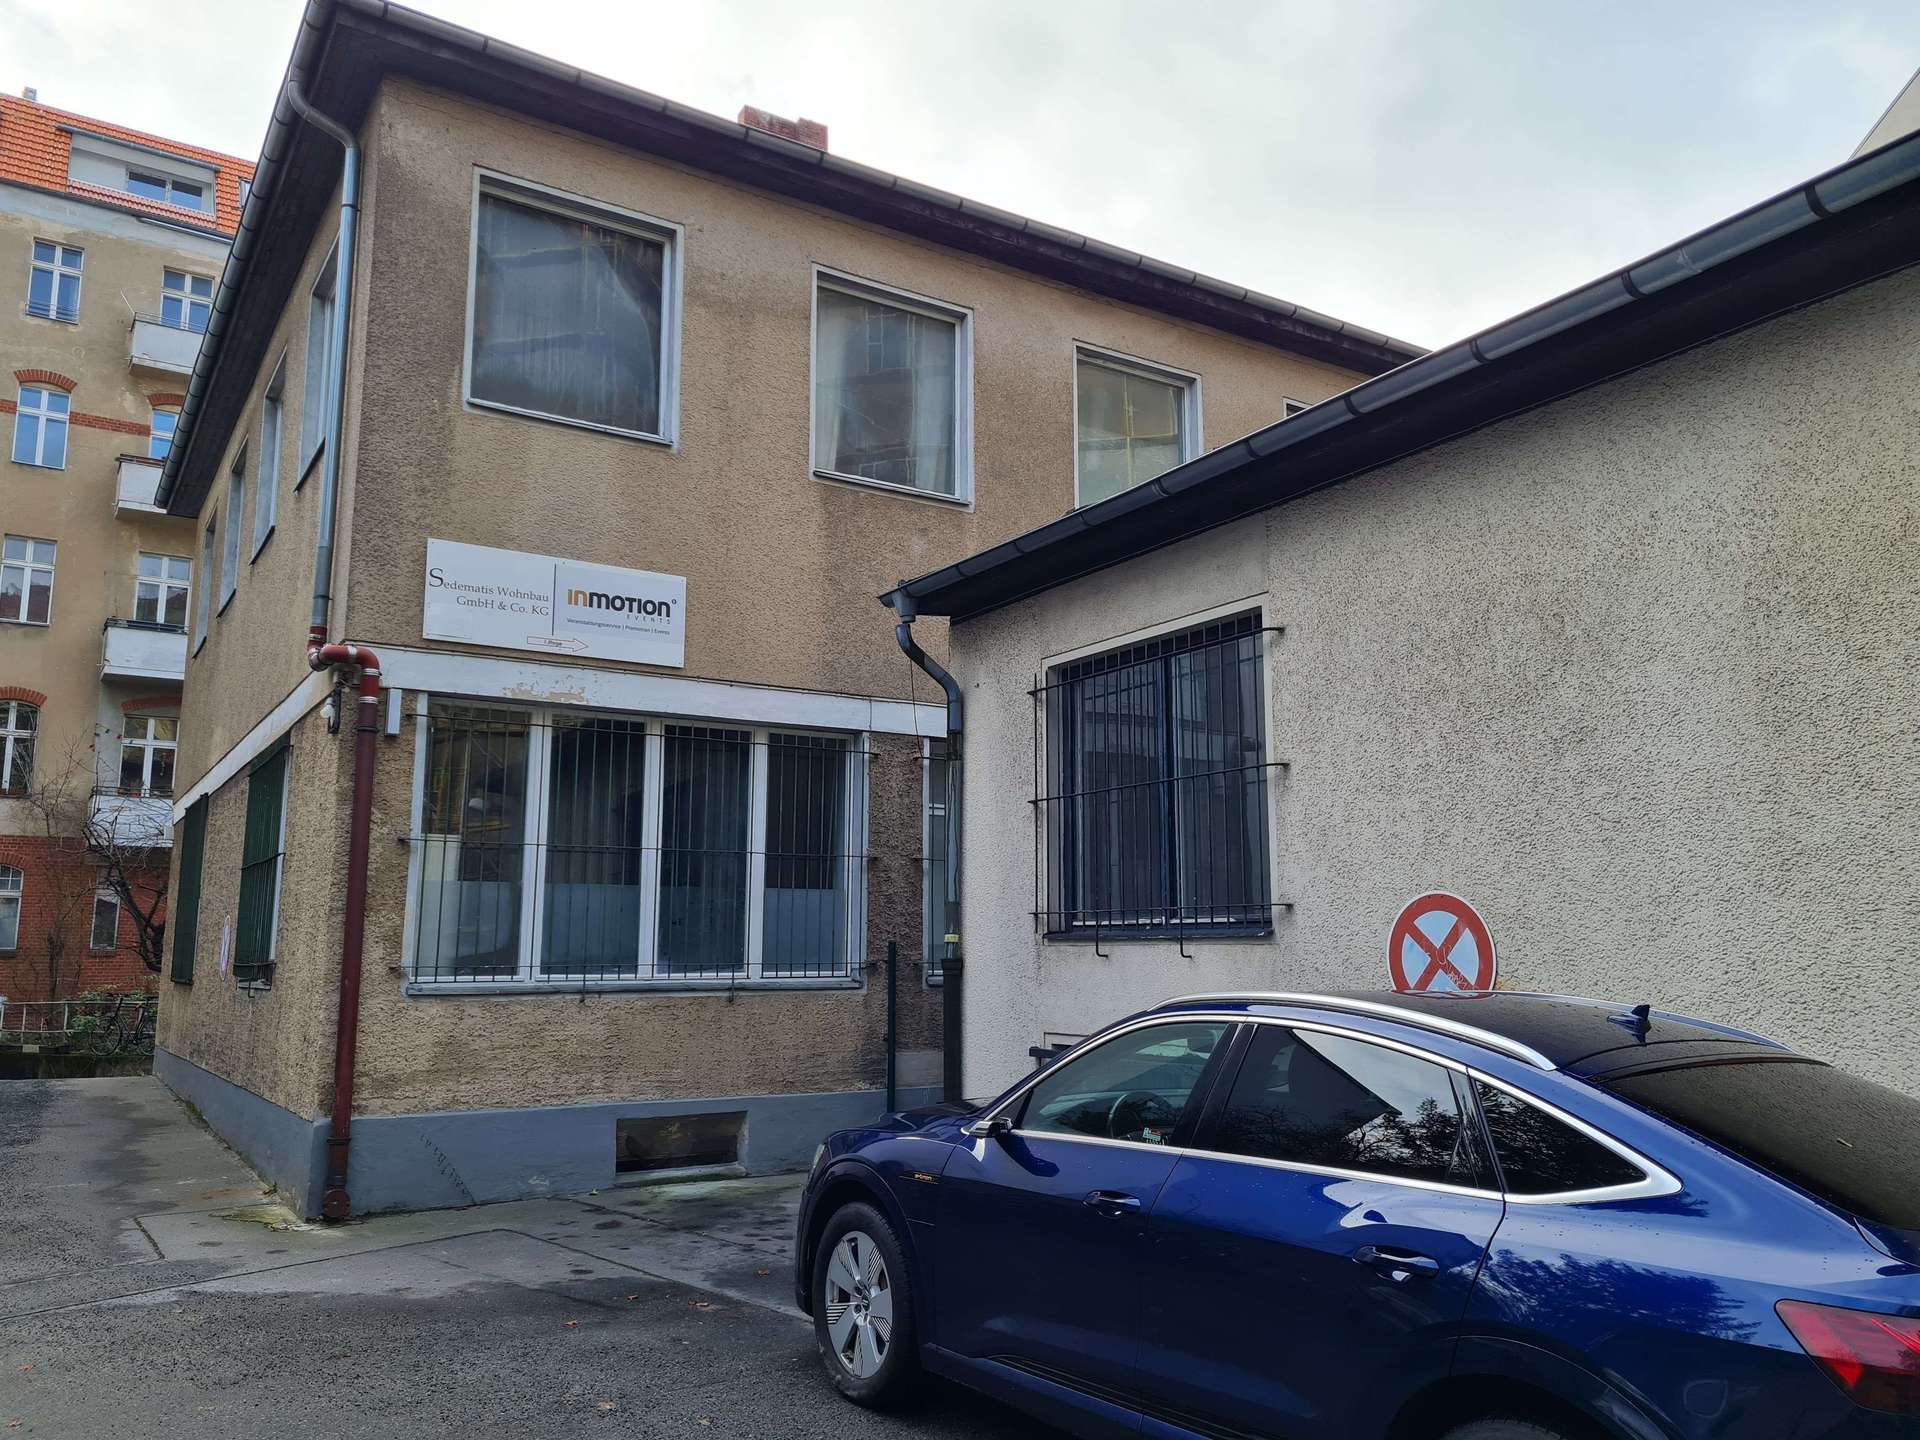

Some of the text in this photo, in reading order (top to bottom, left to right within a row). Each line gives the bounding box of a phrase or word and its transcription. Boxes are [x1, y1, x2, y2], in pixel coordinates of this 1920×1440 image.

[429, 567, 549, 602] Sedematis Wohnbau
[456, 595, 549, 616] GmbH & Co. KG
